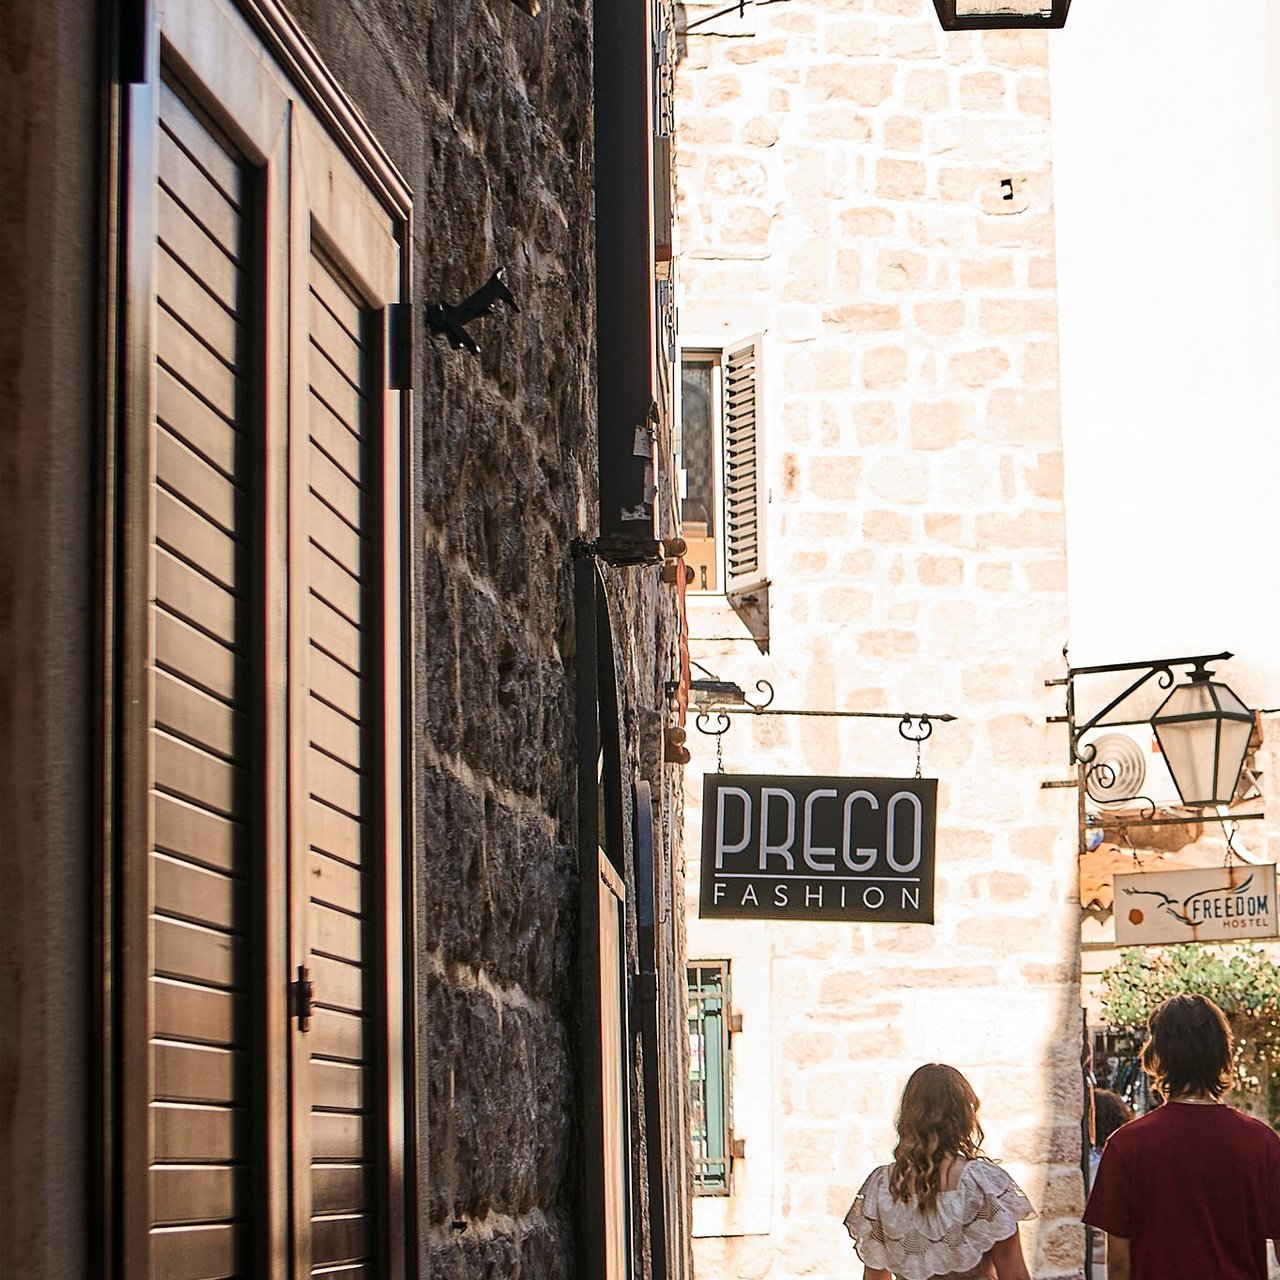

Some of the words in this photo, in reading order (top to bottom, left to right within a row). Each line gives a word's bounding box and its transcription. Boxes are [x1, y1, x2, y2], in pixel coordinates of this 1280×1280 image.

[714, 786, 922, 873] PREGO
[713, 883, 920, 910] FASHION
[1192, 895, 1269, 920] FREEDOM
[1223, 918, 1269, 929] HOSTEL
